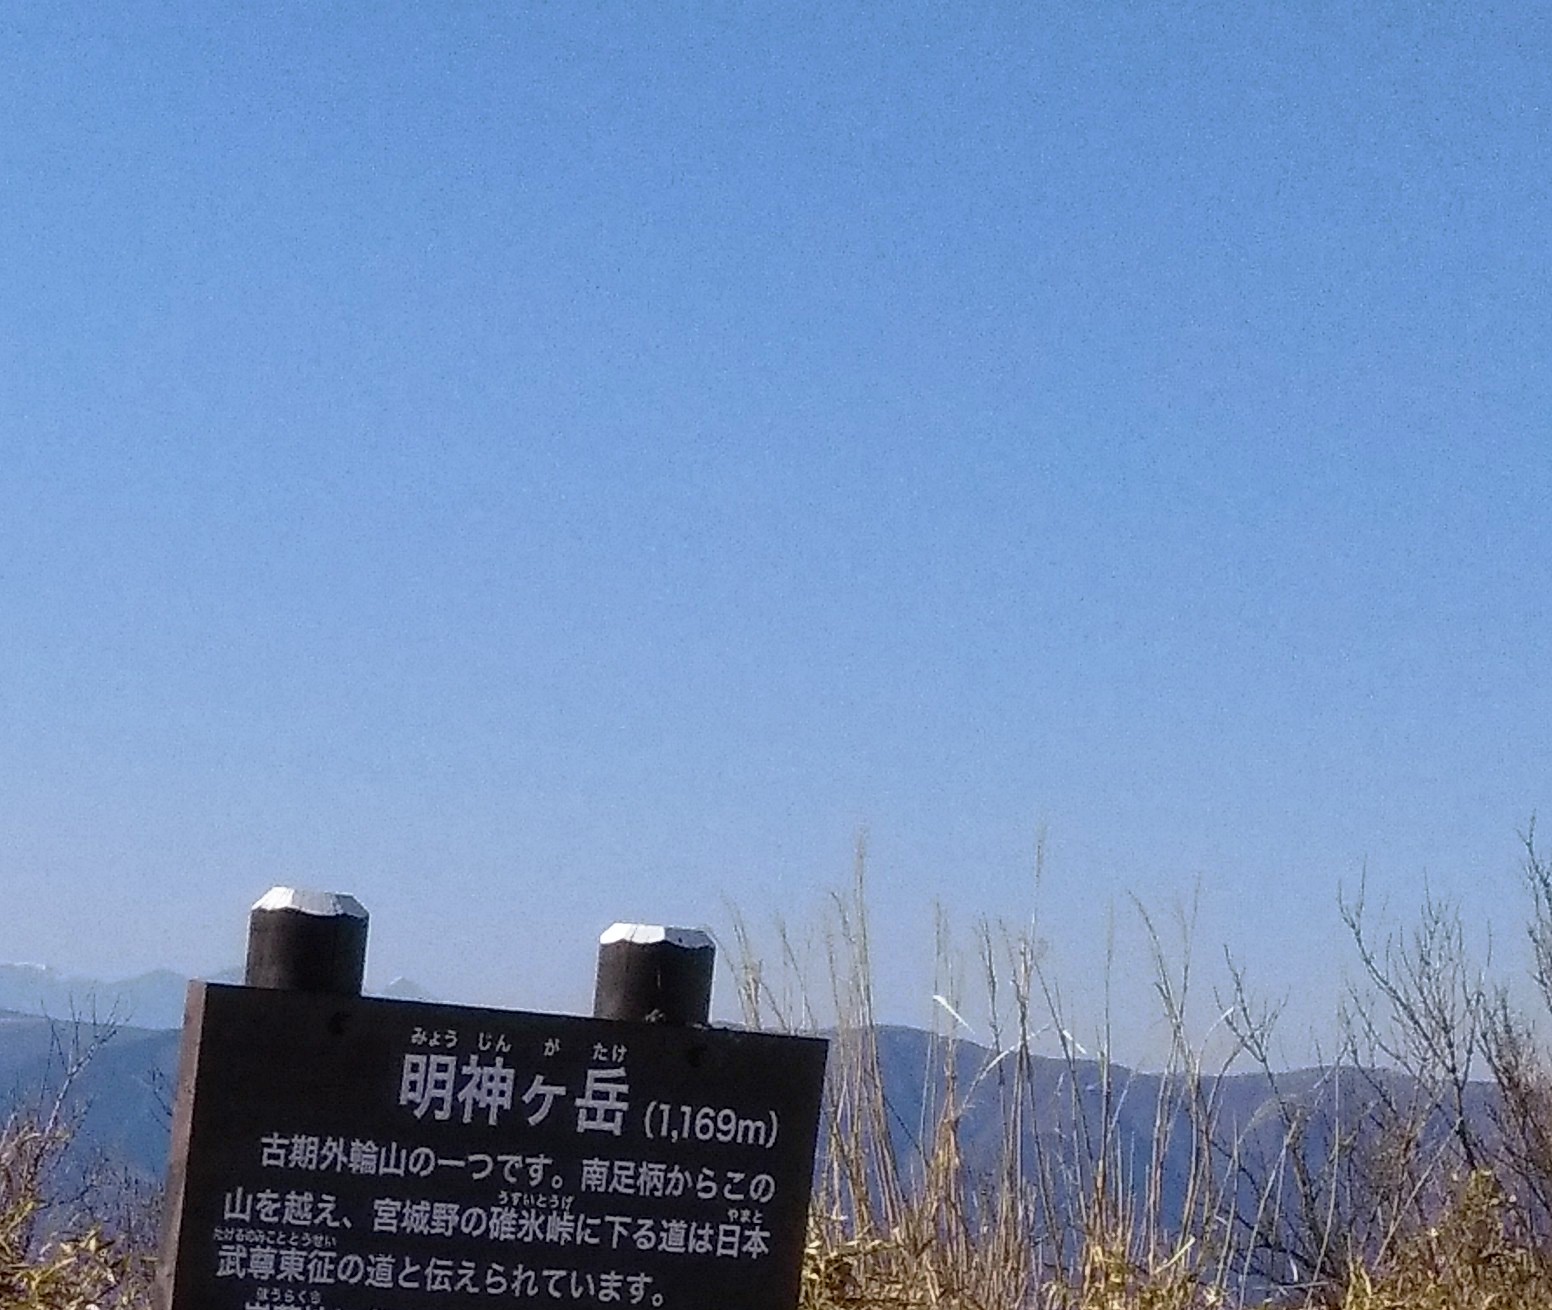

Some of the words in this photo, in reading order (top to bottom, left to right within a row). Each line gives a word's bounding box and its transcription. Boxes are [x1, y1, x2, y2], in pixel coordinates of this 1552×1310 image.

[410, 1027, 458, 1048] みょう
[477, 1032, 512, 1053] じん
[544, 1038, 560, 1056] が
[593, 1042, 627, 1062] たけ
[643, 1101, 778, 1147] (1,169m)
[727, 1208, 763, 1224] やまと
[215, 1244, 664, 1308] 武尊東征の道と伝えられています。
